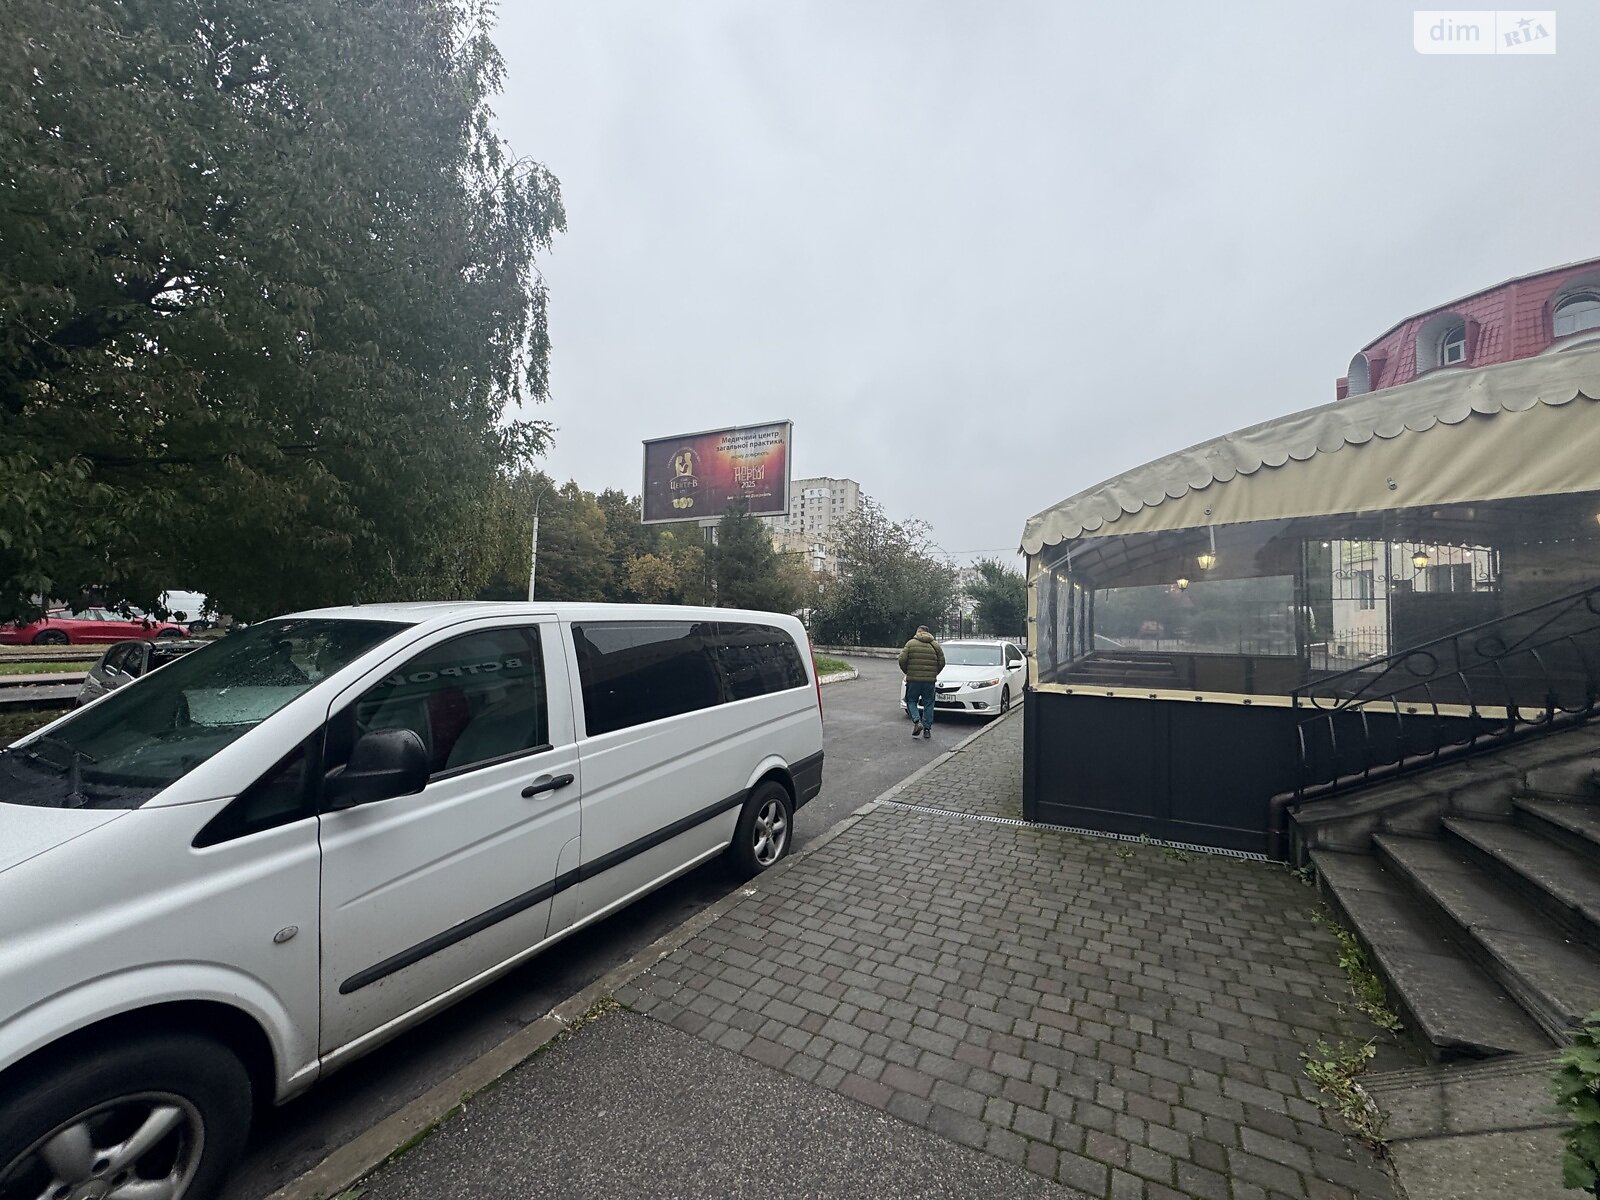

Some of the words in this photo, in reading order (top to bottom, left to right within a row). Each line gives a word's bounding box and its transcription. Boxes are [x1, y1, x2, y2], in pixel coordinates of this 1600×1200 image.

[721, 433, 757, 444] Медичний
[758, 431, 780, 440] центр
[716, 441, 749, 452] загальної
